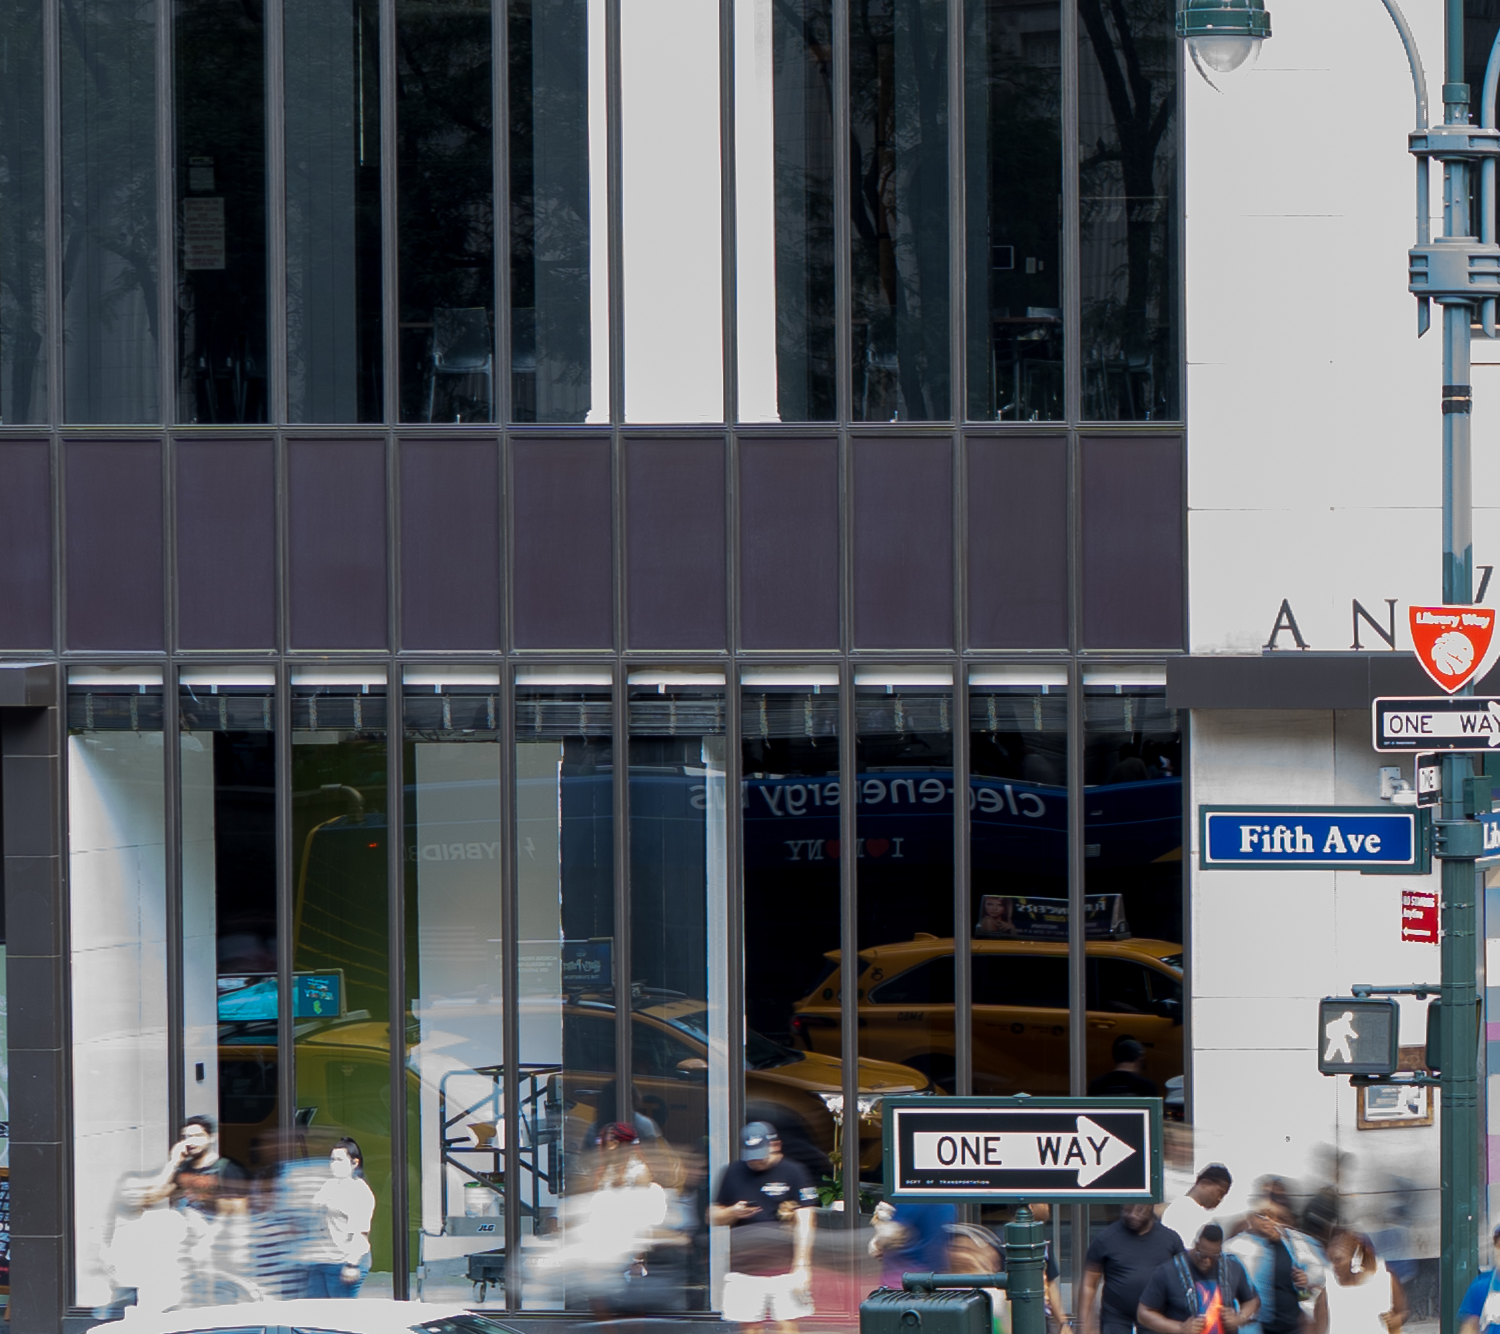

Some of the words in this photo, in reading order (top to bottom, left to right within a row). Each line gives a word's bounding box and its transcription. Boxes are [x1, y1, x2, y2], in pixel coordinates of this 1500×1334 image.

[1389, 714, 1433, 735] ONE
[1240, 825, 1314, 853] Fifth
[1323, 826, 1381, 853] Ave
[938, 1137, 1002, 1165] ONE
[1037, 1137, 1109, 1165] WAY
